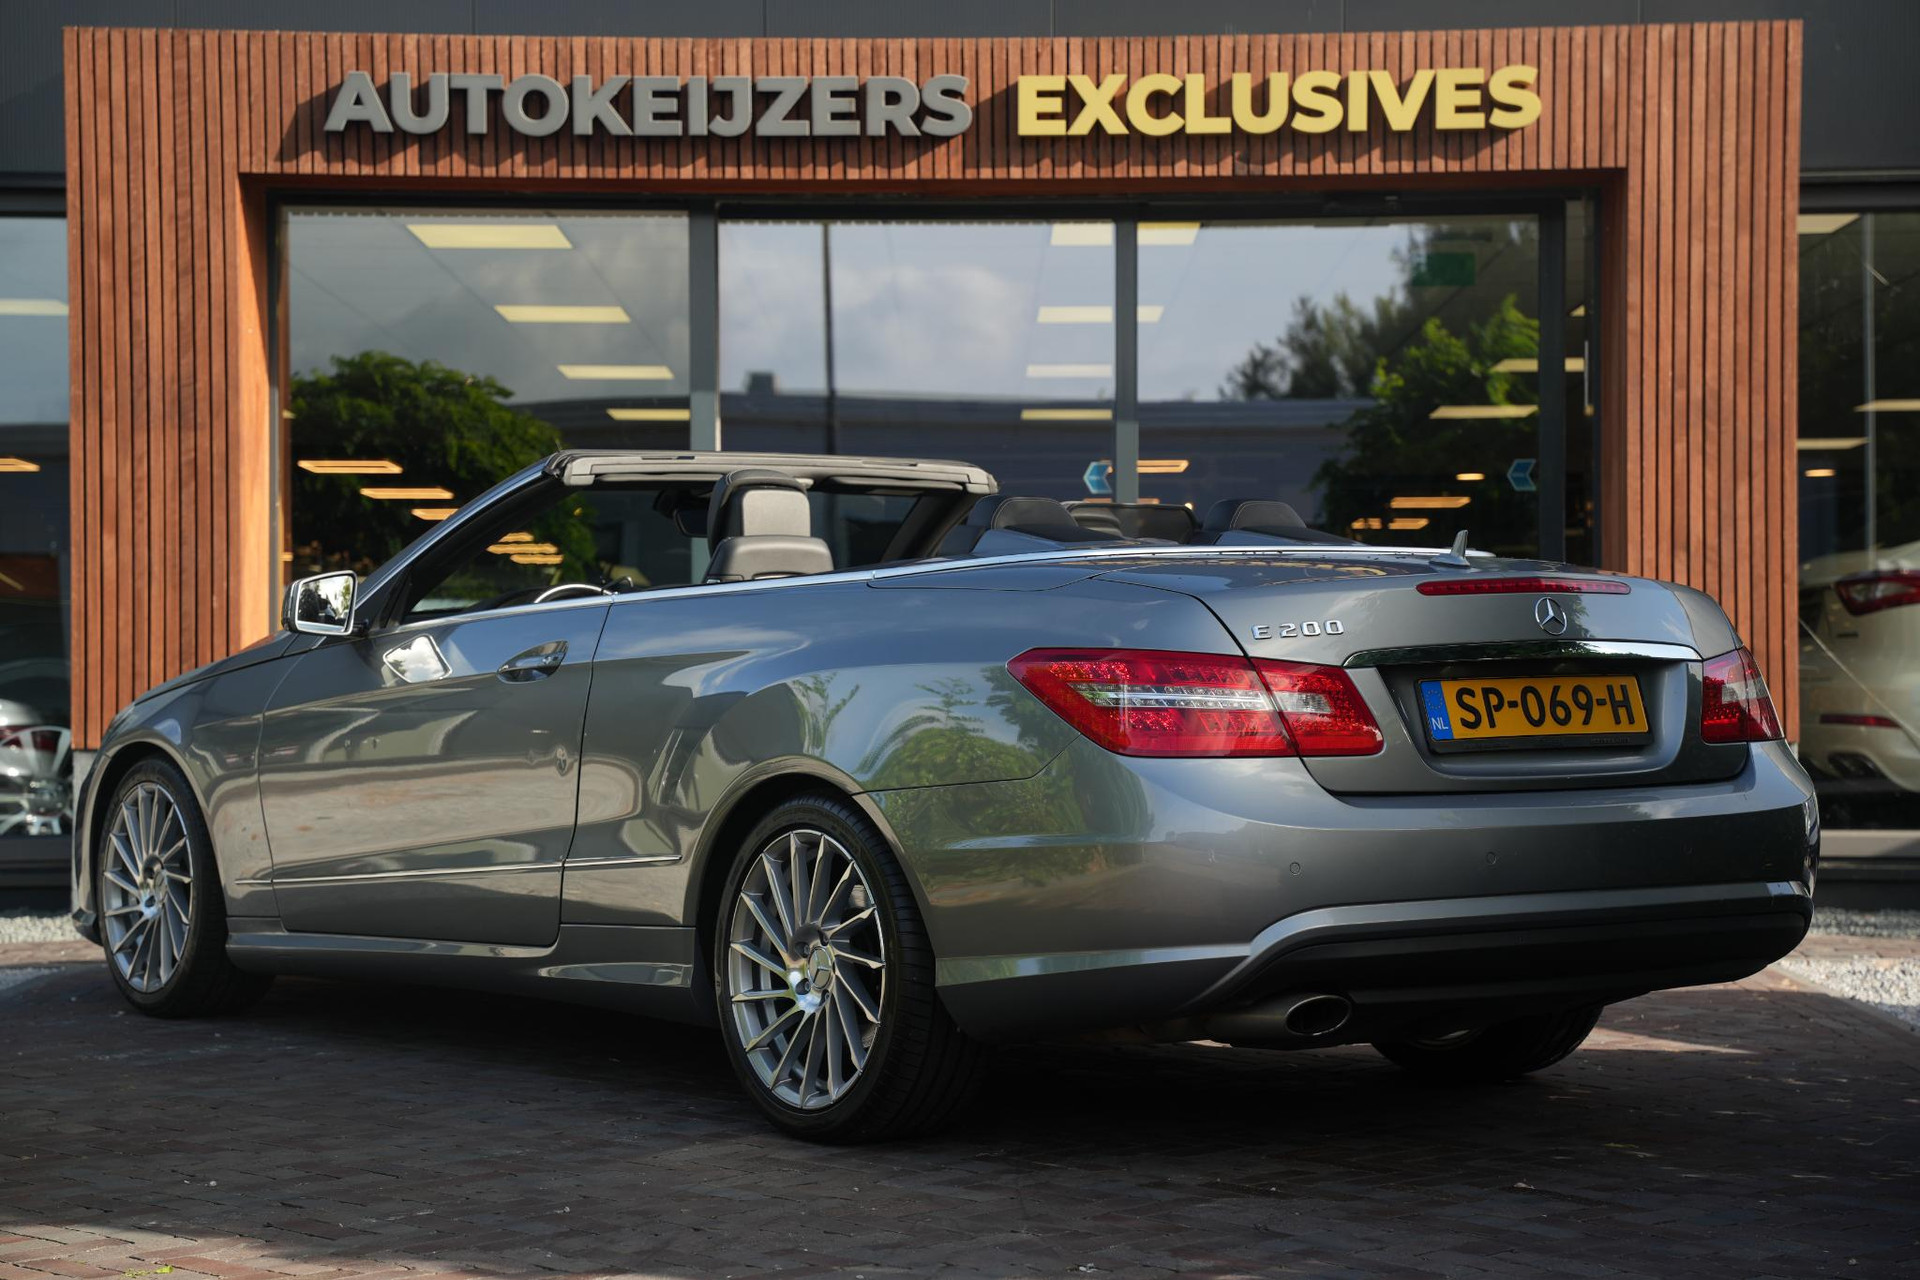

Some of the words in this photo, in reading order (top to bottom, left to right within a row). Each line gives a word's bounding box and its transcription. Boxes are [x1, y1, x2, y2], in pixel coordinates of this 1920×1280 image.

[323, 70, 973, 138] AUTOKEIJZERS
[1017, 64, 1542, 137] EXCLUSIVES
[1251, 625, 1272, 640] E
[1279, 620, 1345, 638] 200
[1431, 717, 1449, 730] NL
[1455, 684, 1636, 730] SP-069-H
